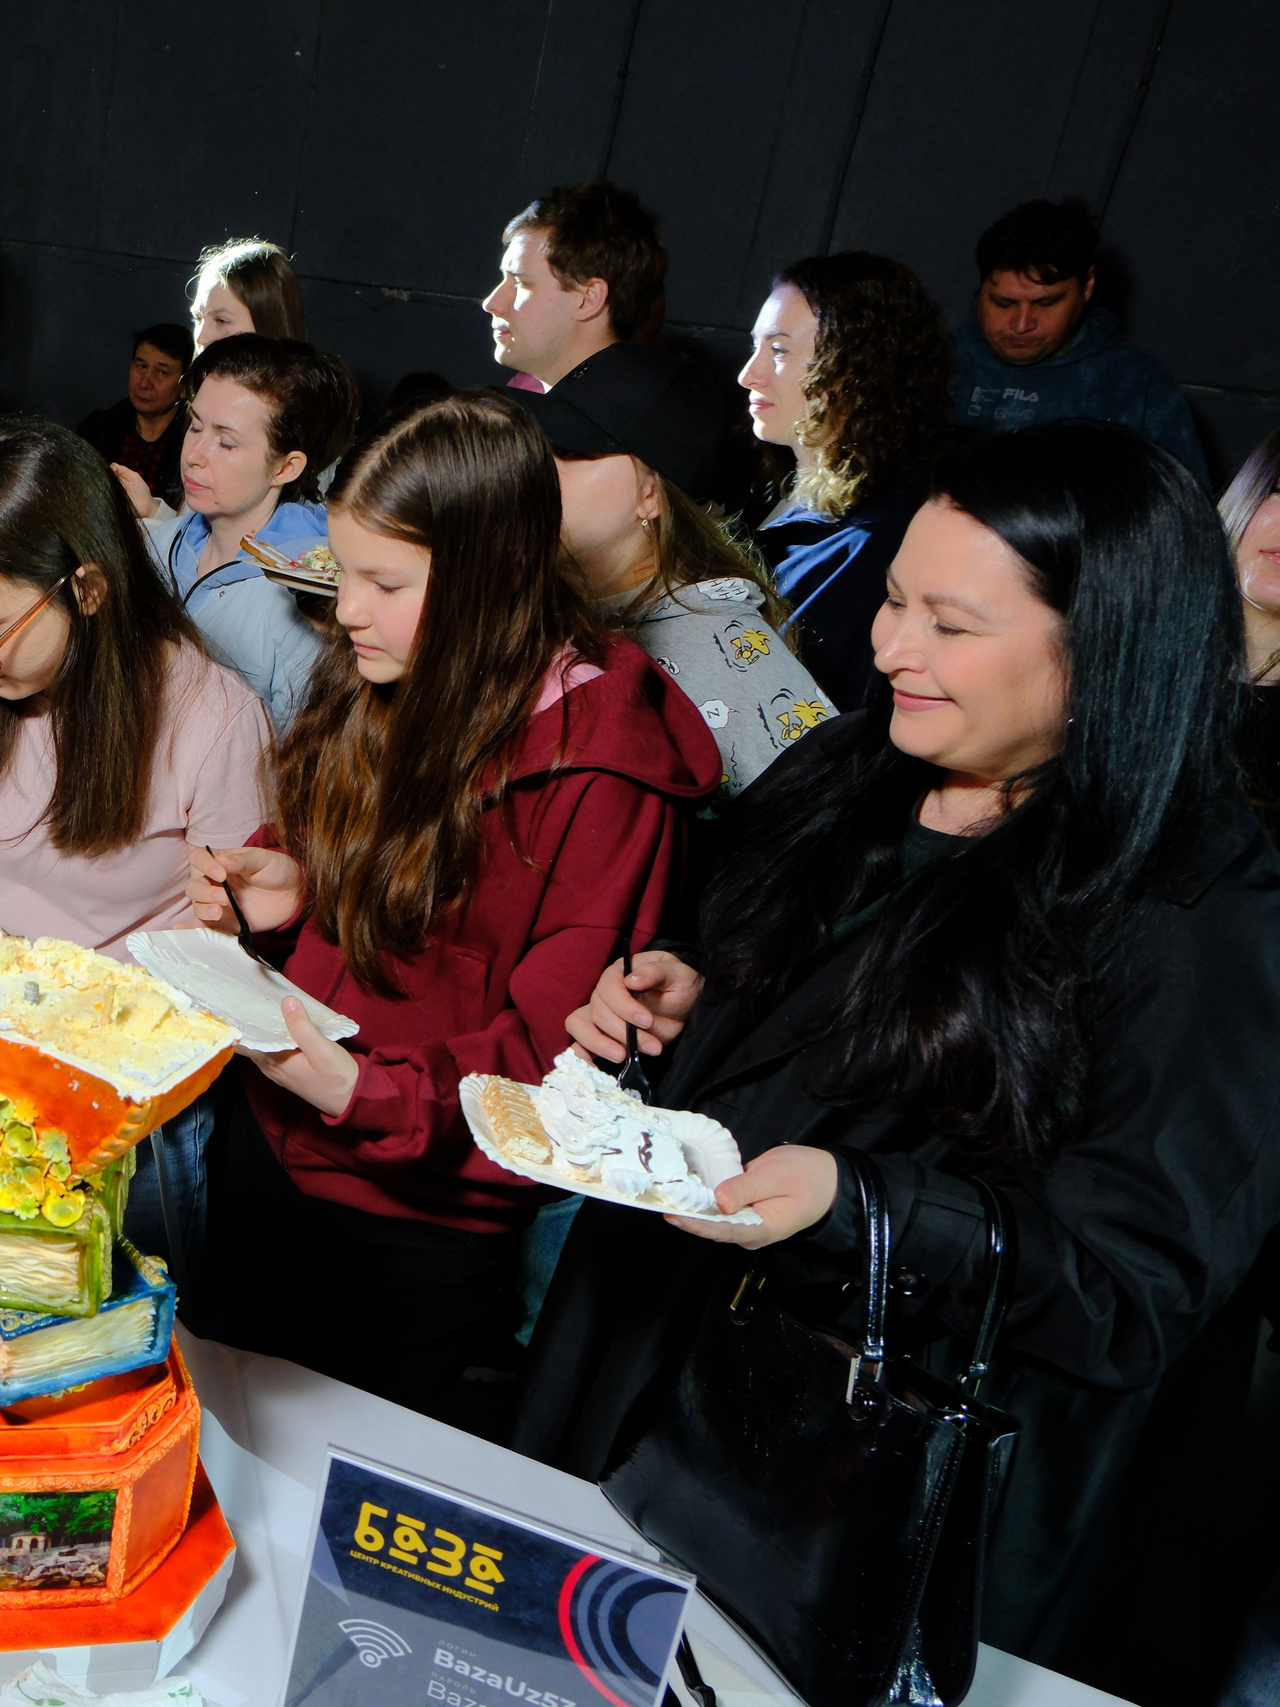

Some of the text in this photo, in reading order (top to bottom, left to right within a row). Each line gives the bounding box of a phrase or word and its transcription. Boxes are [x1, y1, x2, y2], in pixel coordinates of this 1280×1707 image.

[1002, 387, 1039, 402] FILA
[349, 1549, 500, 1613] ЦЕНТР КРЕАТИВНЫХ ИНДУСТРИЙ
